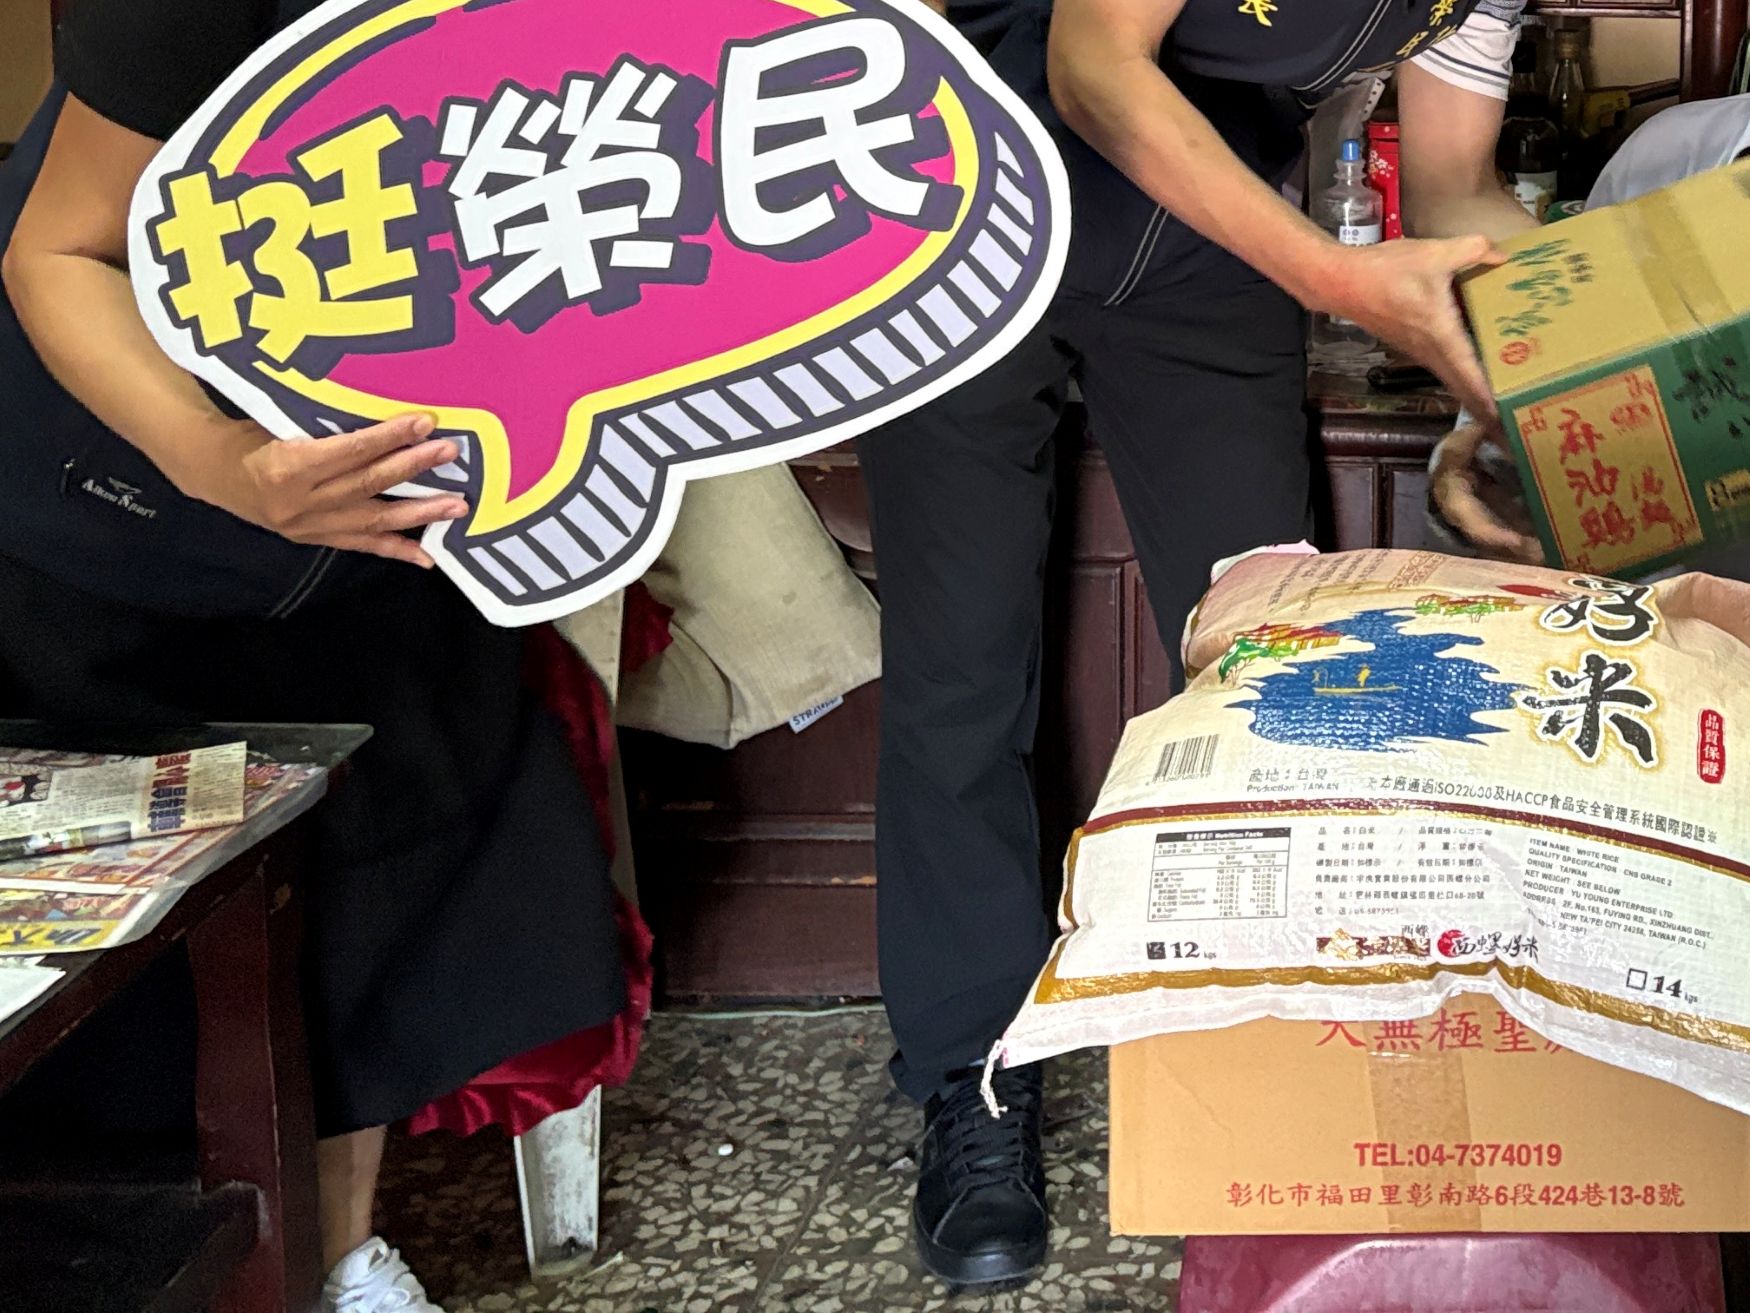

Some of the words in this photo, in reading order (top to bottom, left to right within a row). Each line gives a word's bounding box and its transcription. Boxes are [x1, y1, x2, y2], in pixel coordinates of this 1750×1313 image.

[158, 18, 932, 364] 挺榮民
[1522, 579, 1655, 764] 好米
[1702, 713, 1722, 778] 品質保證
[1529, 847, 1560, 861] QUALITY
[1562, 854, 1617, 873] SPECIFICATION
[1530, 838, 1548, 848] ITEM
[1577, 848, 1600, 859] WHITE
[1602, 853, 1619, 863] RICE
[1527, 858, 1552, 869] ORIGIN
[1560, 865, 1587, 877] TAIWAN
[1525, 869, 1539, 879] NET
[1541, 872, 1570, 885] WEIGHT
[1577, 879, 1591, 889] SEE
[1594, 882, 1620, 895] BELOW
[1523, 880, 1564, 895] PRODUCER
[1583, 892, 1609, 905] YOUNG
[1611, 899, 1657, 916] ENTERPRISE
[1560, 911, 1577, 921] NEW
[1604, 920, 1622, 931] CITY
[1170, 941, 1200, 959] 12
[1653, 975, 1682, 998] 14
[1354, 1143, 1562, 1167] TEL:04-7374019
[1225, 1182, 1685, 1208] 彰化市福田里彰南路6段424巷13-8號
